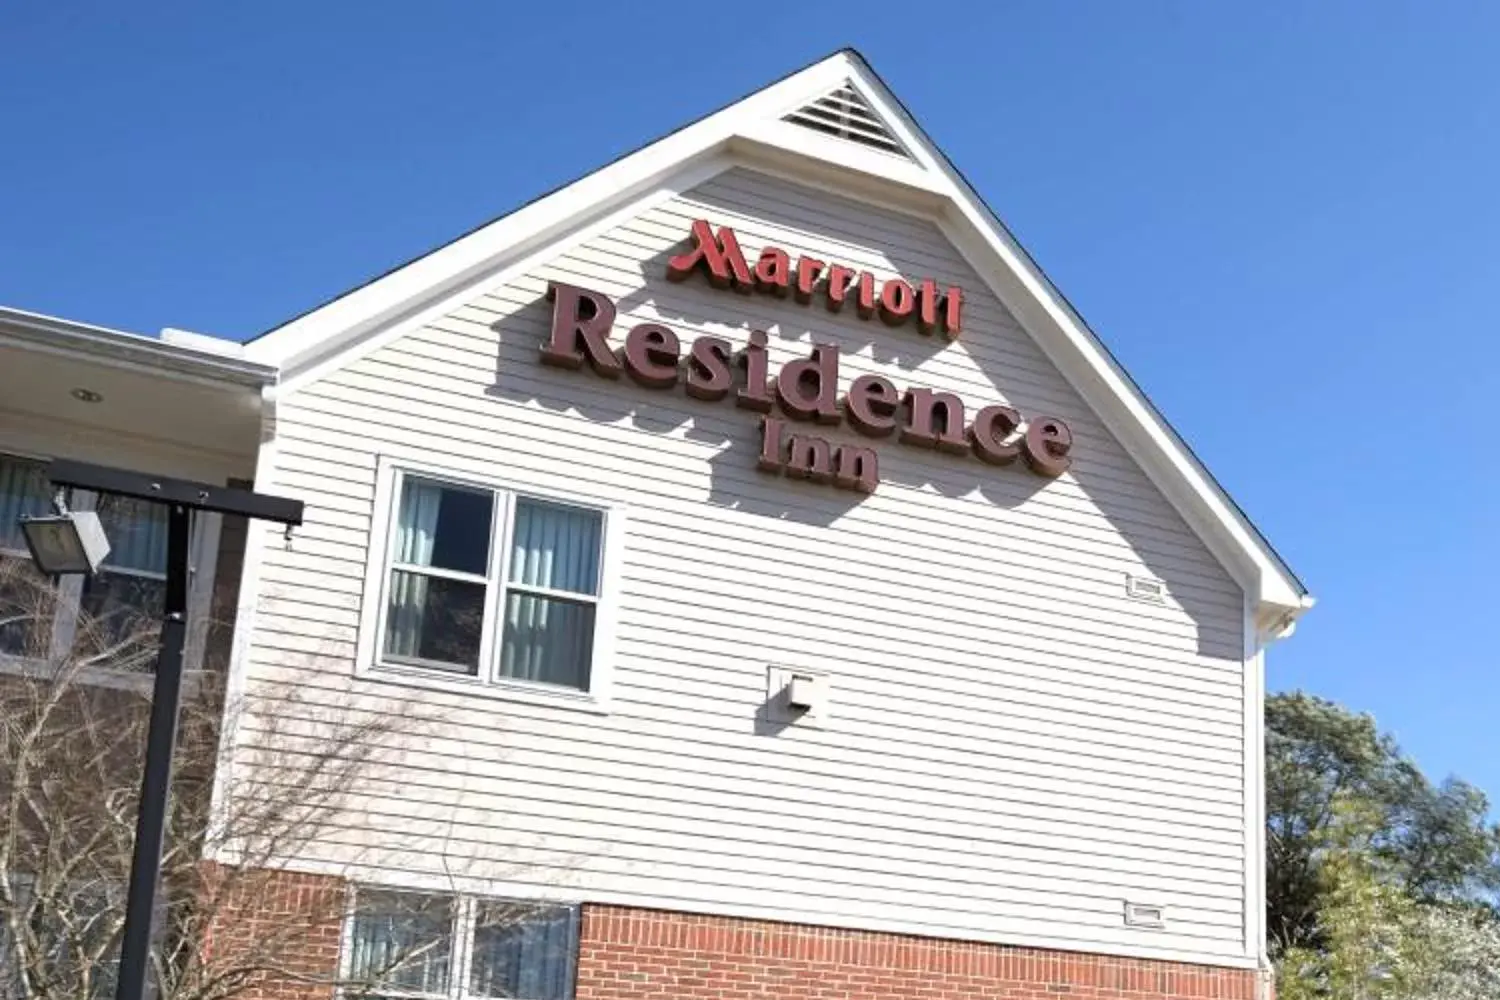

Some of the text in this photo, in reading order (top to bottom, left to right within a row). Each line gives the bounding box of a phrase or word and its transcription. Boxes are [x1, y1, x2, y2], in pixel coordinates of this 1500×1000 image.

[666, 219, 963, 339] Marriott
[539, 280, 1074, 477] Residence
[757, 414, 879, 493] Inn
